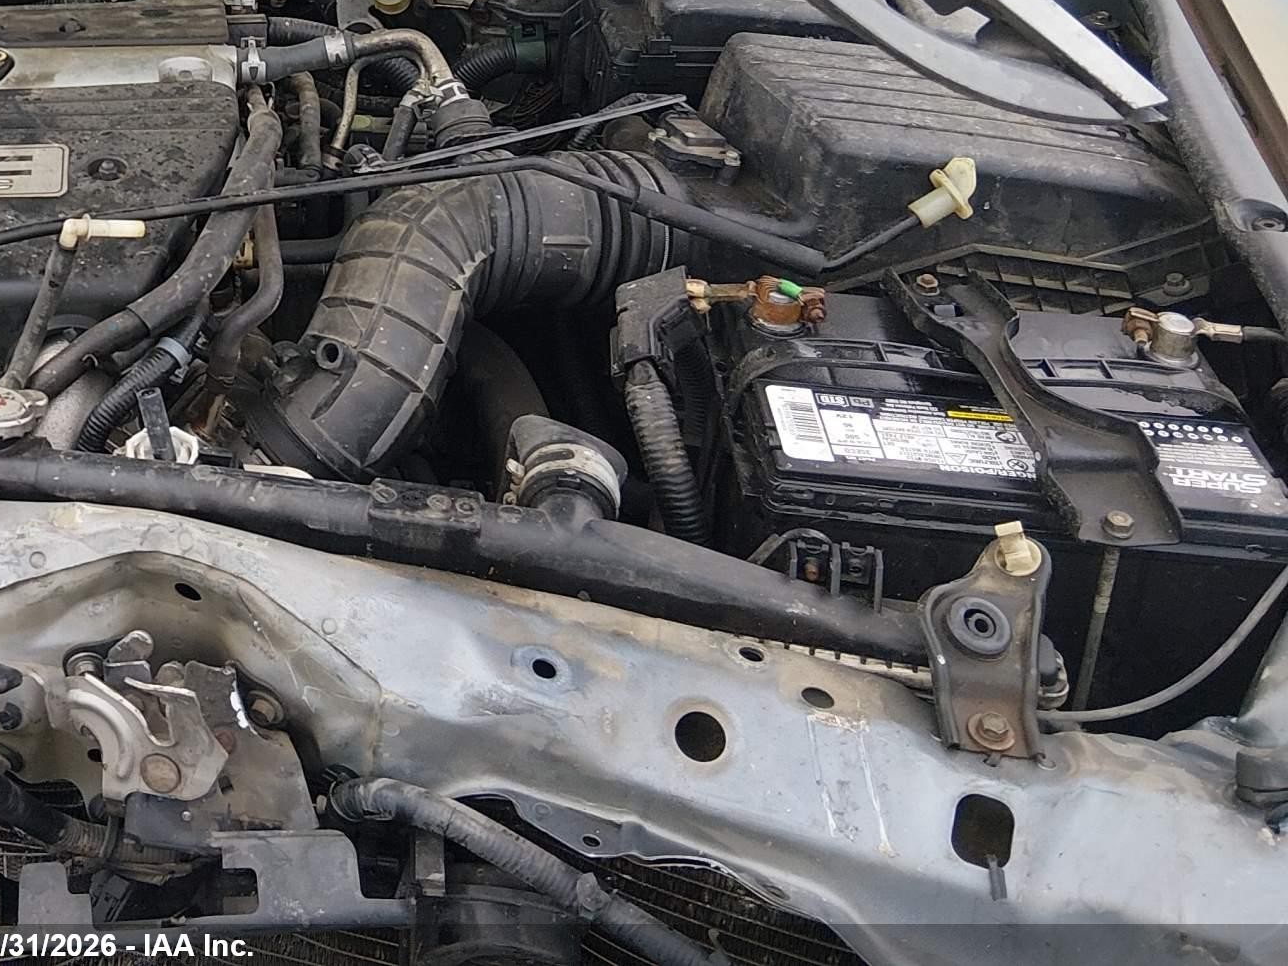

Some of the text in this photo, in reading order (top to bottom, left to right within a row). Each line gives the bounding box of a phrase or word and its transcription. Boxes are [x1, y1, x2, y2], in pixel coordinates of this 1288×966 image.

[939, 464, 1036, 479] NGER/POISON
[1165, 467, 1267, 486] START
[1173, 477, 1262, 493] SUPER
